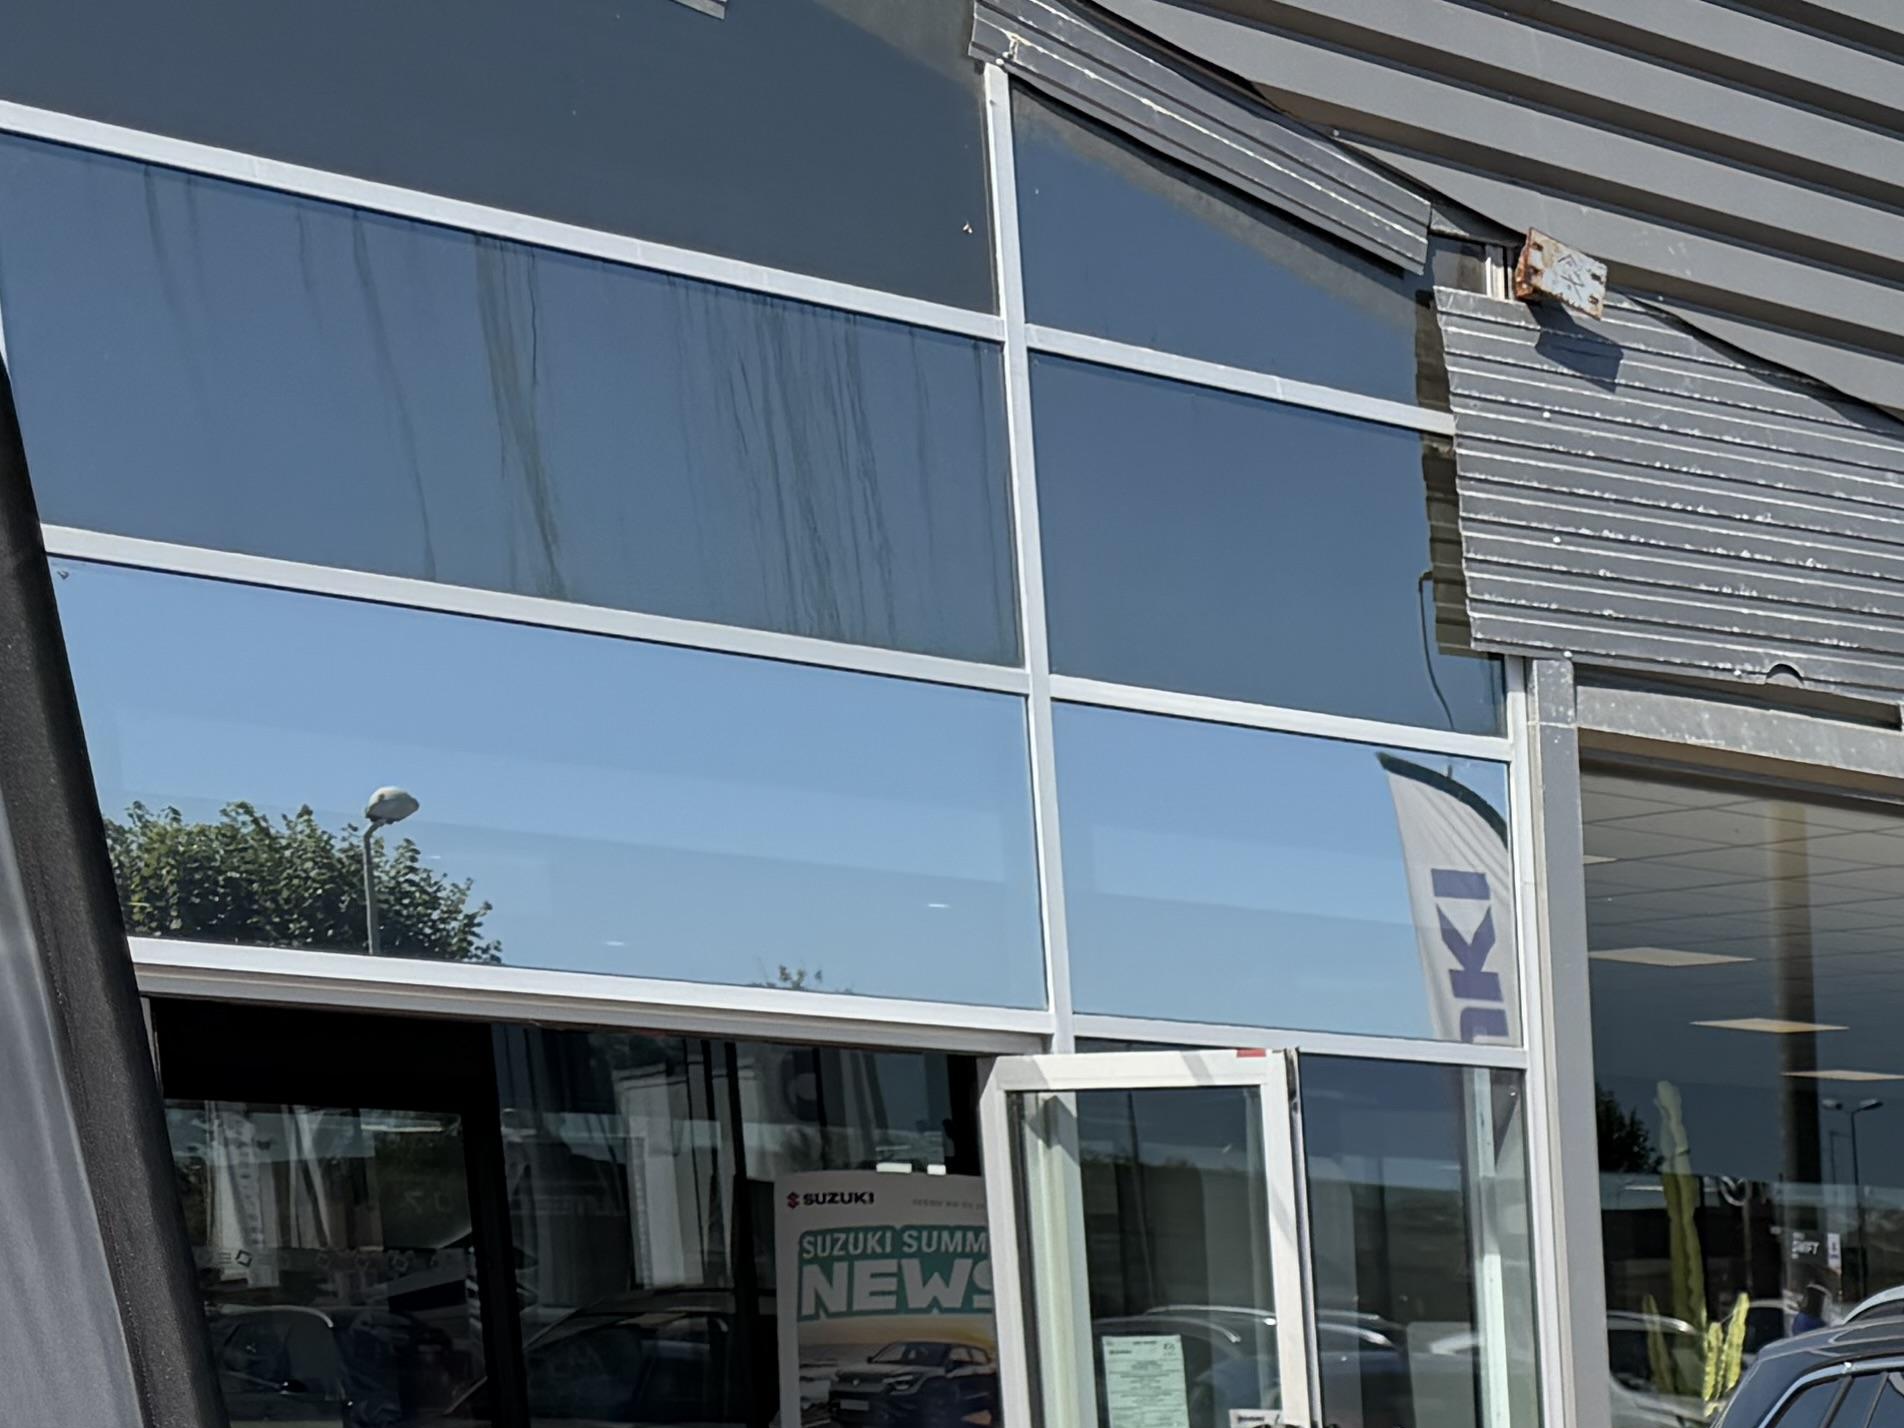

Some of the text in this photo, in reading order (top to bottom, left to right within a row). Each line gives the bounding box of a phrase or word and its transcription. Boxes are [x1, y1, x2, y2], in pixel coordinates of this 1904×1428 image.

[803, 1191, 875, 1206] SUZUKI
[802, 1230, 988, 1259] SUZUKI SUMM
[800, 1258, 994, 1317] NEWS
